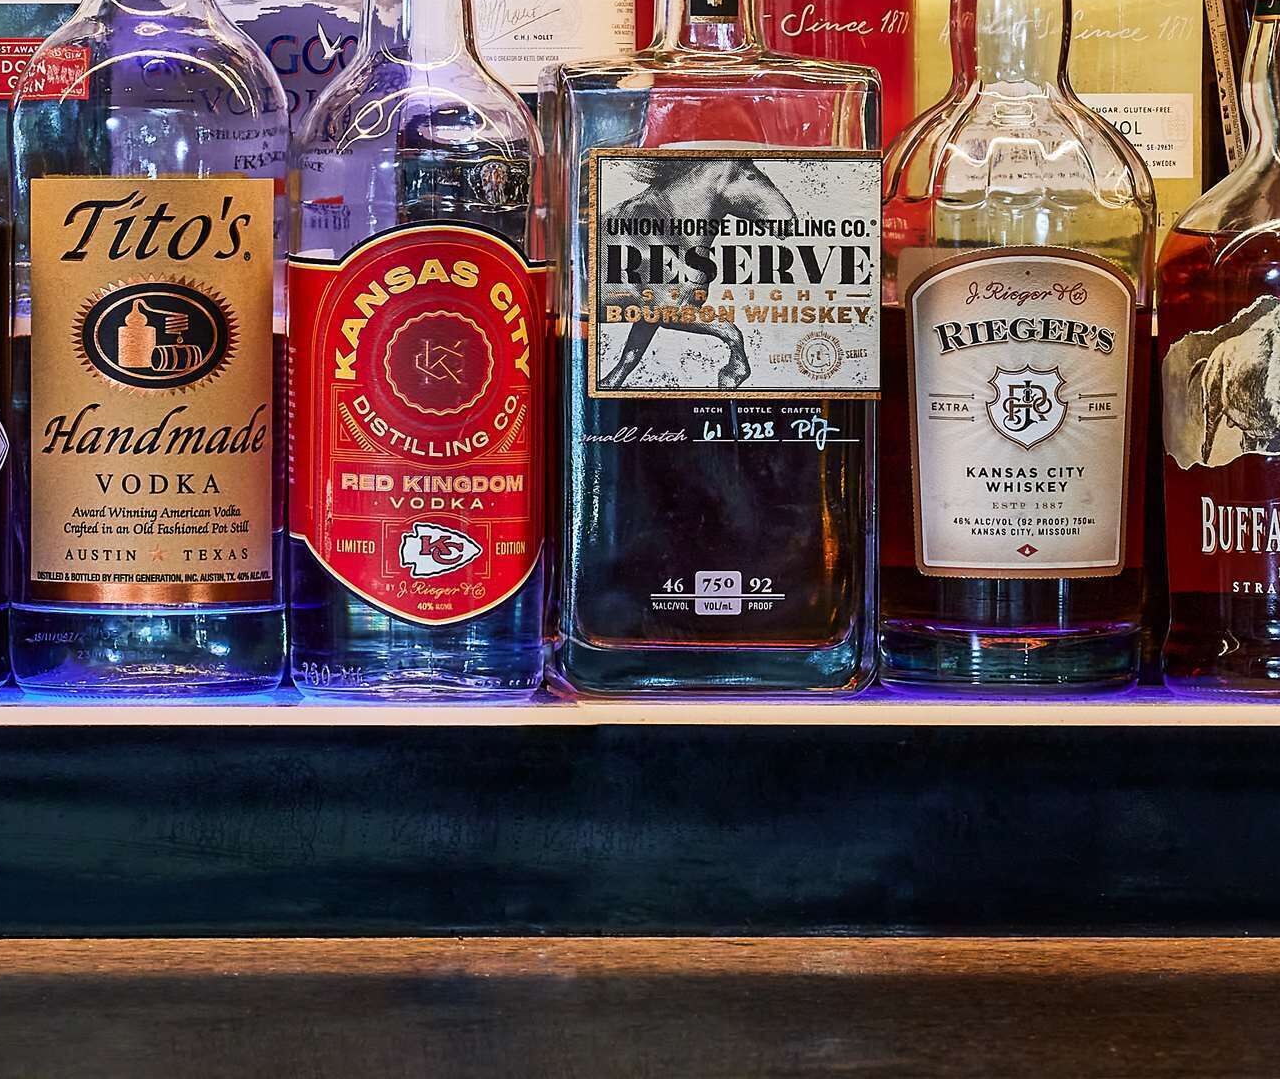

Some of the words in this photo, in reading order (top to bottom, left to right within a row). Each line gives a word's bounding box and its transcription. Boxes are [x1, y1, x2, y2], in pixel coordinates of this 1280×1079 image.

[60, 190, 251, 261] Tito's
[607, 220, 663, 236] UNION
[673, 220, 730, 236] HORSE
[736, 220, 835, 237] DISTILLING
[841, 220, 870, 237] CO.
[605, 245, 871, 285] RESERVE
[335, 259, 479, 380] KANSAS
[490, 282, 530, 379] CITY
[606, 305, 735, 323] BOURBON
[745, 307, 870, 324] WHISKEY
[934, 318, 1116, 354] RIEGER'S
[931, 403, 969, 412] EXTRA
[1089, 403, 1111, 411] FINE
[42, 403, 267, 454] Handmade
[353, 395, 489, 457] DISTILLING
[967, 467, 1038, 478] KANSAS
[1047, 468, 1085, 477] CITY
[95, 474, 220, 494] VODKA
[342, 473, 394, 491] RED
[403, 475, 523, 493] KINGDOM
[986, 482, 1068, 493] WHISKEY
[390, 497, 483, 509] VODKA
[72, 507, 106, 518] Award
[108, 508, 157, 520] Winning
[161, 508, 210, 518] American
[213, 505, 241, 517] Vodka
[971, 528, 1008, 536] KANSAS
[1011, 529, 1034, 537] CITY,
[1038, 528, 1079, 536] MISSOURI
[337, 539, 375, 553] LIMITED
[420, 535, 463, 564] KC
[496, 541, 525, 555] EDITION
[65, 549, 136, 561] AUSTIN
[184, 549, 248, 560] TEXAS
[663, 578, 684, 592] 46
[702, 578, 734, 591] 750
[749, 578, 772, 592] 92
